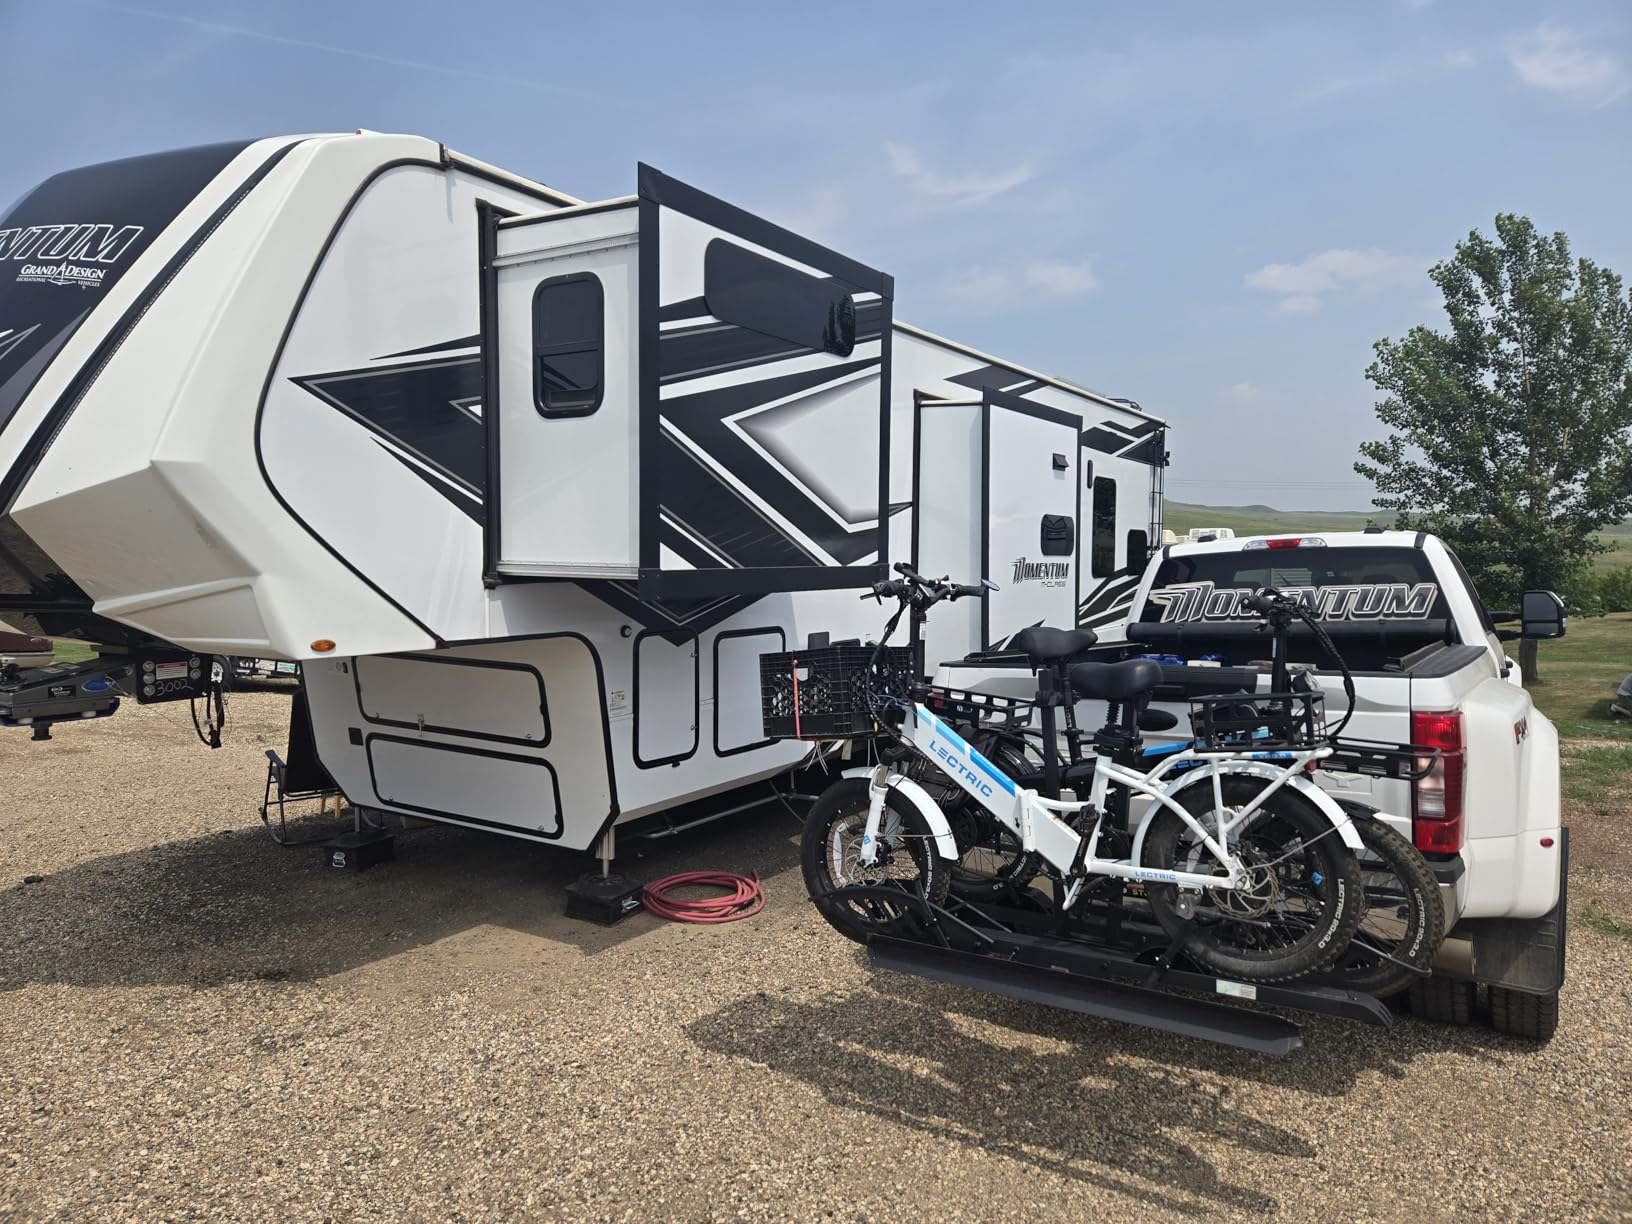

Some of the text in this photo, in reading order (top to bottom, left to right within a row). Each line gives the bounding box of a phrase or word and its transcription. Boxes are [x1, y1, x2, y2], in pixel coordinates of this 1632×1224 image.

[0, 224, 144, 263] NTUM
[21, 264, 106, 279] GRAND DESIGN
[1009, 556, 1070, 584] MOMENTUM
[1149, 581, 1438, 623] MOMNTUM
[156, 679, 194, 697] 3002
[929, 740, 993, 797] LECTRIC
[1135, 871, 1176, 880] LECTRIC
[1334, 878, 1345, 920] LECTRIC
[1413, 888, 1426, 926] LECTRIC
